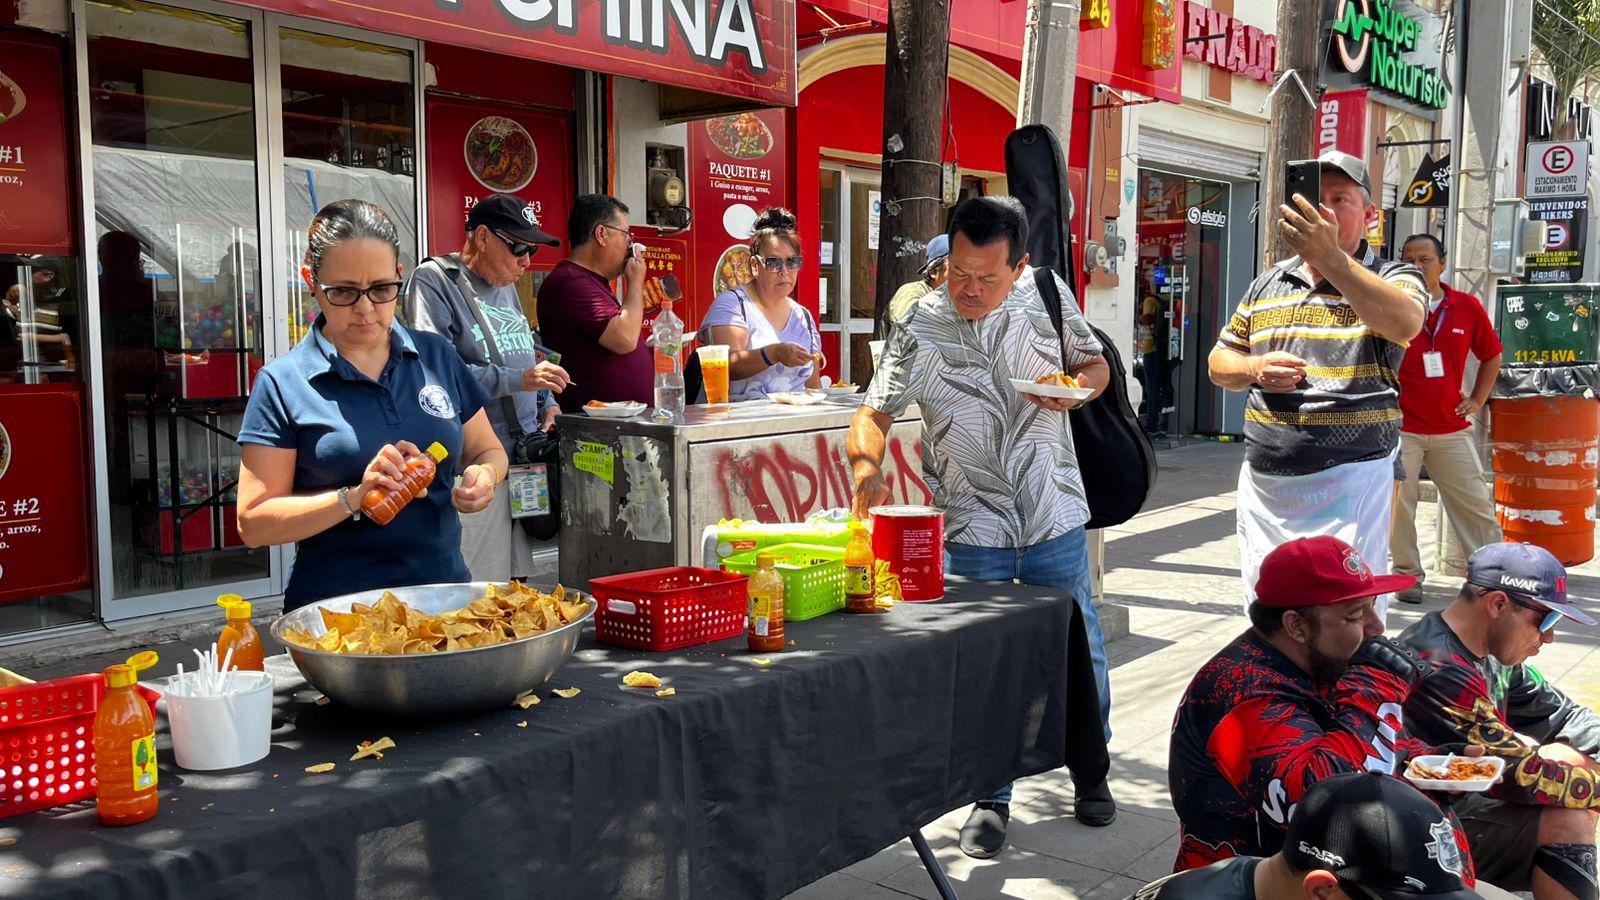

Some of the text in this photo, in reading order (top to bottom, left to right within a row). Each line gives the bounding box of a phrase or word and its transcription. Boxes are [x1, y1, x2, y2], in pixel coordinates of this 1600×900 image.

[501, 0, 765, 70] INA
[1370, 37, 1449, 110] Naturista
[1550, 150, 1566, 169] E
[709, 161, 771, 181] PAQUETE #1
[1534, 175, 1578, 186] ESTACIONAMIENTO
[1561, 184, 1577, 193] HORA
[1530, 201, 1588, 212] IENVENIDOS
[1541, 210, 1574, 220] BIKERS
[1547, 227, 1561, 244] E
[1551, 349, 1577, 362] kVA
[13, 497, 40, 516] #2
[7, 524, 42, 535] arroz,
